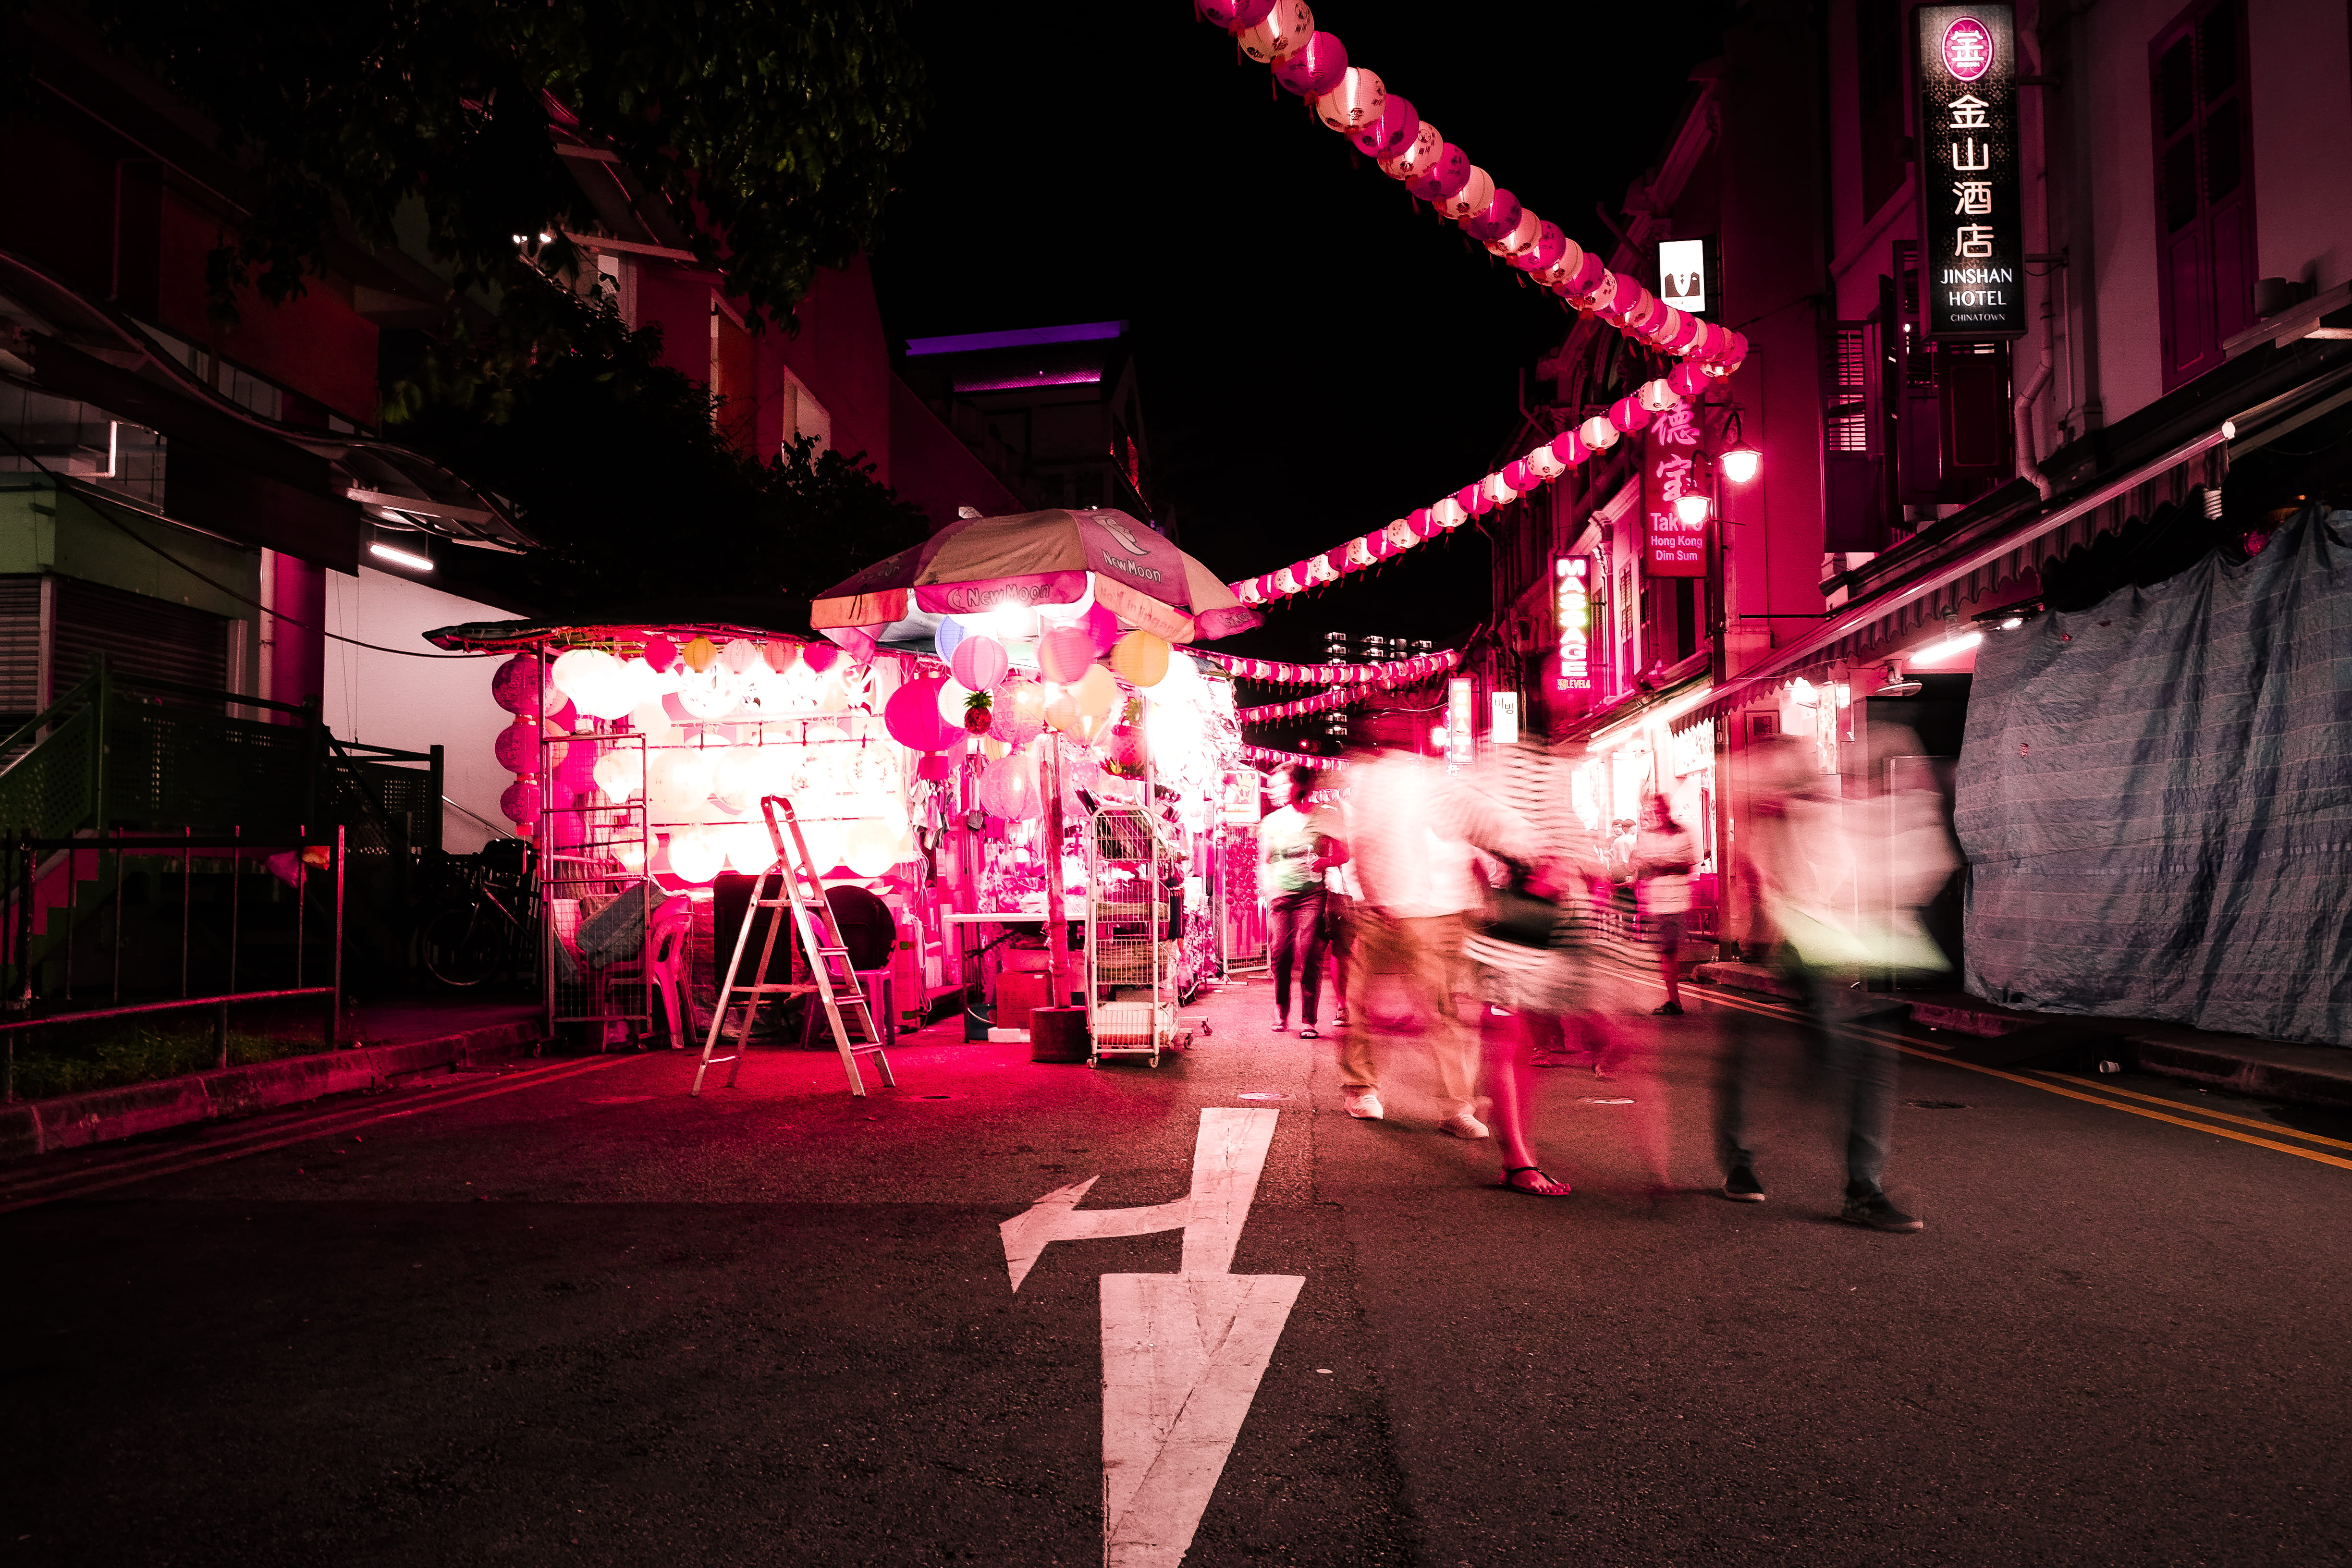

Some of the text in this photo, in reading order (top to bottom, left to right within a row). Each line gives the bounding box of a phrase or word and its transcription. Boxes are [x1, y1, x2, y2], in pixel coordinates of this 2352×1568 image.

[1948, 94, 1994, 257] 金山酒店
[1940, 268, 2012, 284] JINSHAN
[1949, 291, 2007, 306] HOTEL
[1950, 313, 2005, 322] CHINATOWN
[1651, 535, 1703, 548] Hong Kong
[1655, 550, 1698, 561] Dim Sum
[1557, 560, 1588, 677] MASSAGE
